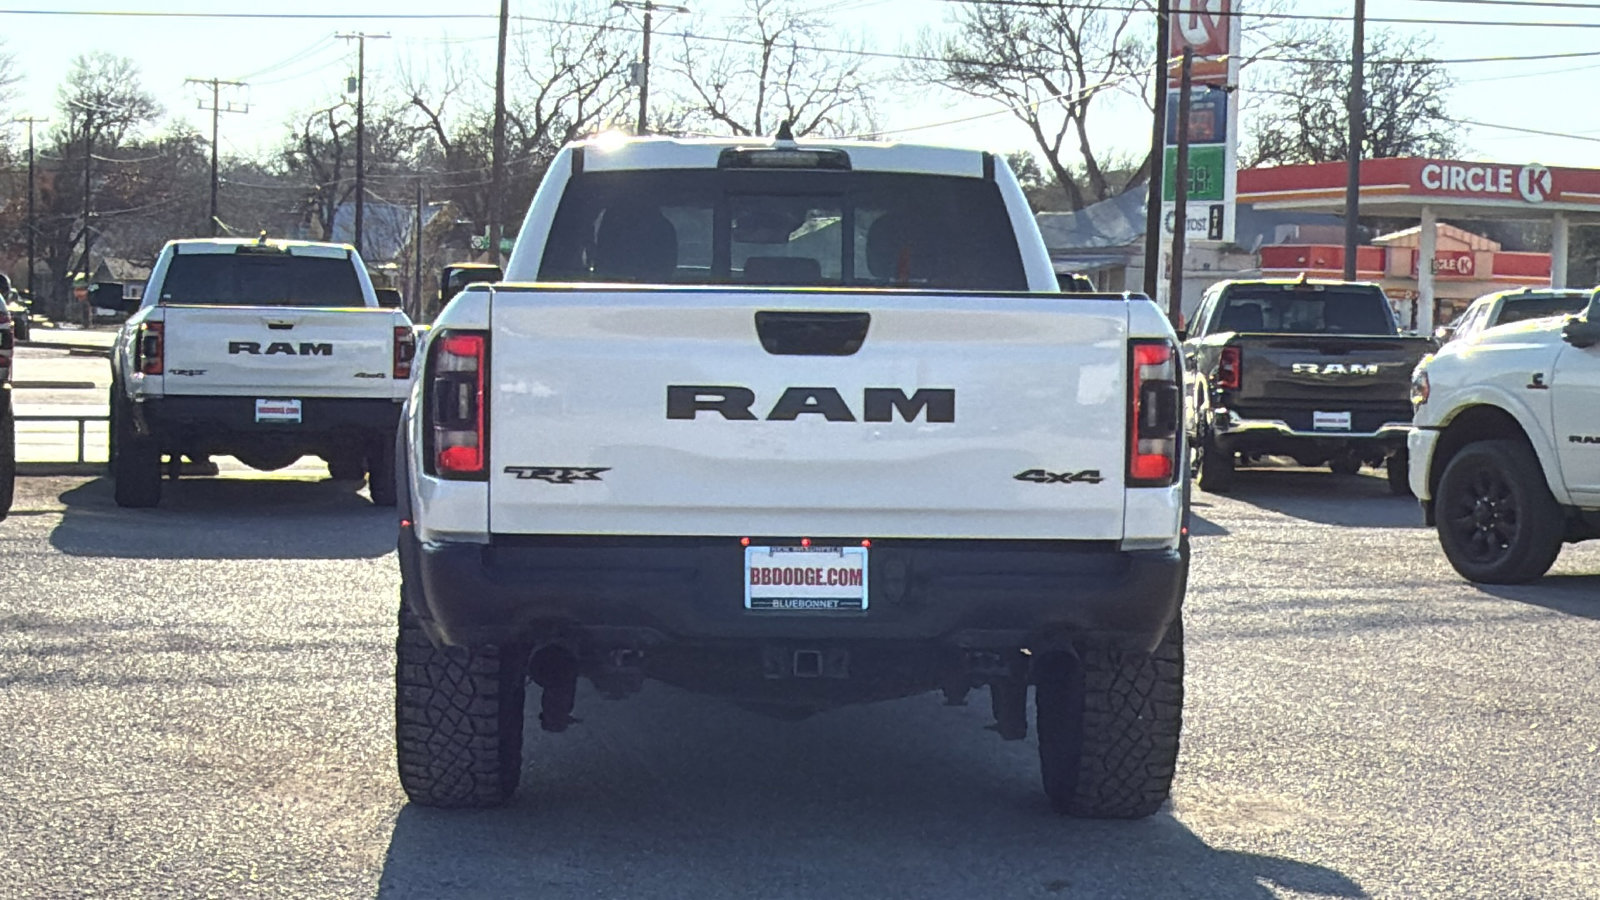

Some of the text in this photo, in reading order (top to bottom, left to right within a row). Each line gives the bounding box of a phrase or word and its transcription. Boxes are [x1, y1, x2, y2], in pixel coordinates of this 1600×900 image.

[1421, 164, 1550, 202] CIRCLE K
[1186, 217, 1207, 231] rost
[228, 341, 333, 356] RAM
[1292, 363, 1378, 375] RAM
[666, 385, 956, 423] RAM
[503, 466, 612, 484] TRX
[1013, 469, 1105, 484] 4x4
[750, 567, 863, 586] BBDODGE.COM
[772, 599, 840, 609] BLUEBONNET
